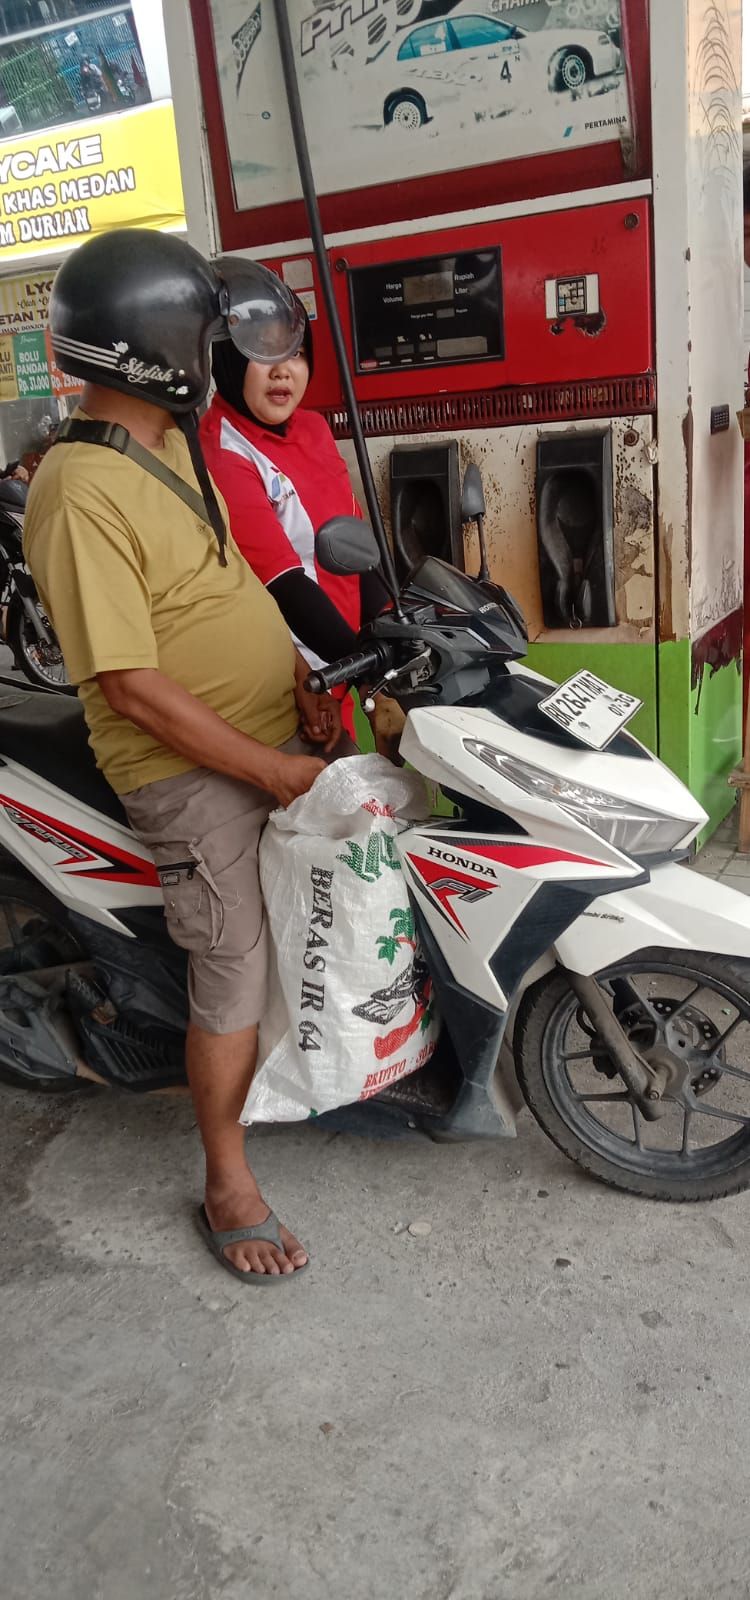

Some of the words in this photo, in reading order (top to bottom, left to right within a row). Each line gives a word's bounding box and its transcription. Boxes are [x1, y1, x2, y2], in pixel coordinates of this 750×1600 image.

[500, 60, 512, 84] 4
[584, 115, 627, 131] PERTAMINA
[3, 183, 57, 215] KHAS
[60, 166, 136, 204] MEDAN
[18, 206, 92, 244] DURIAN
[385, 283, 402, 291] Harga
[454, 272, 475, 281] Rupiah
[383, 296, 403, 304] Volume
[454, 287, 468, 295] Liter
[17, 362, 48, 375] PANDAN
[19, 351, 39, 362] BOLU
[118, 357, 174, 384] Stylish
[556, 683, 597, 717] 2647
[3, 806, 90, 860] VARIO
[427, 846, 498, 879] HONDA
[303, 864, 335, 973] BERAS
[300, 977, 325, 1012] IR
[298, 1020, 323, 1052] 64
[363, 1058, 407, 1088] BRUTTO
